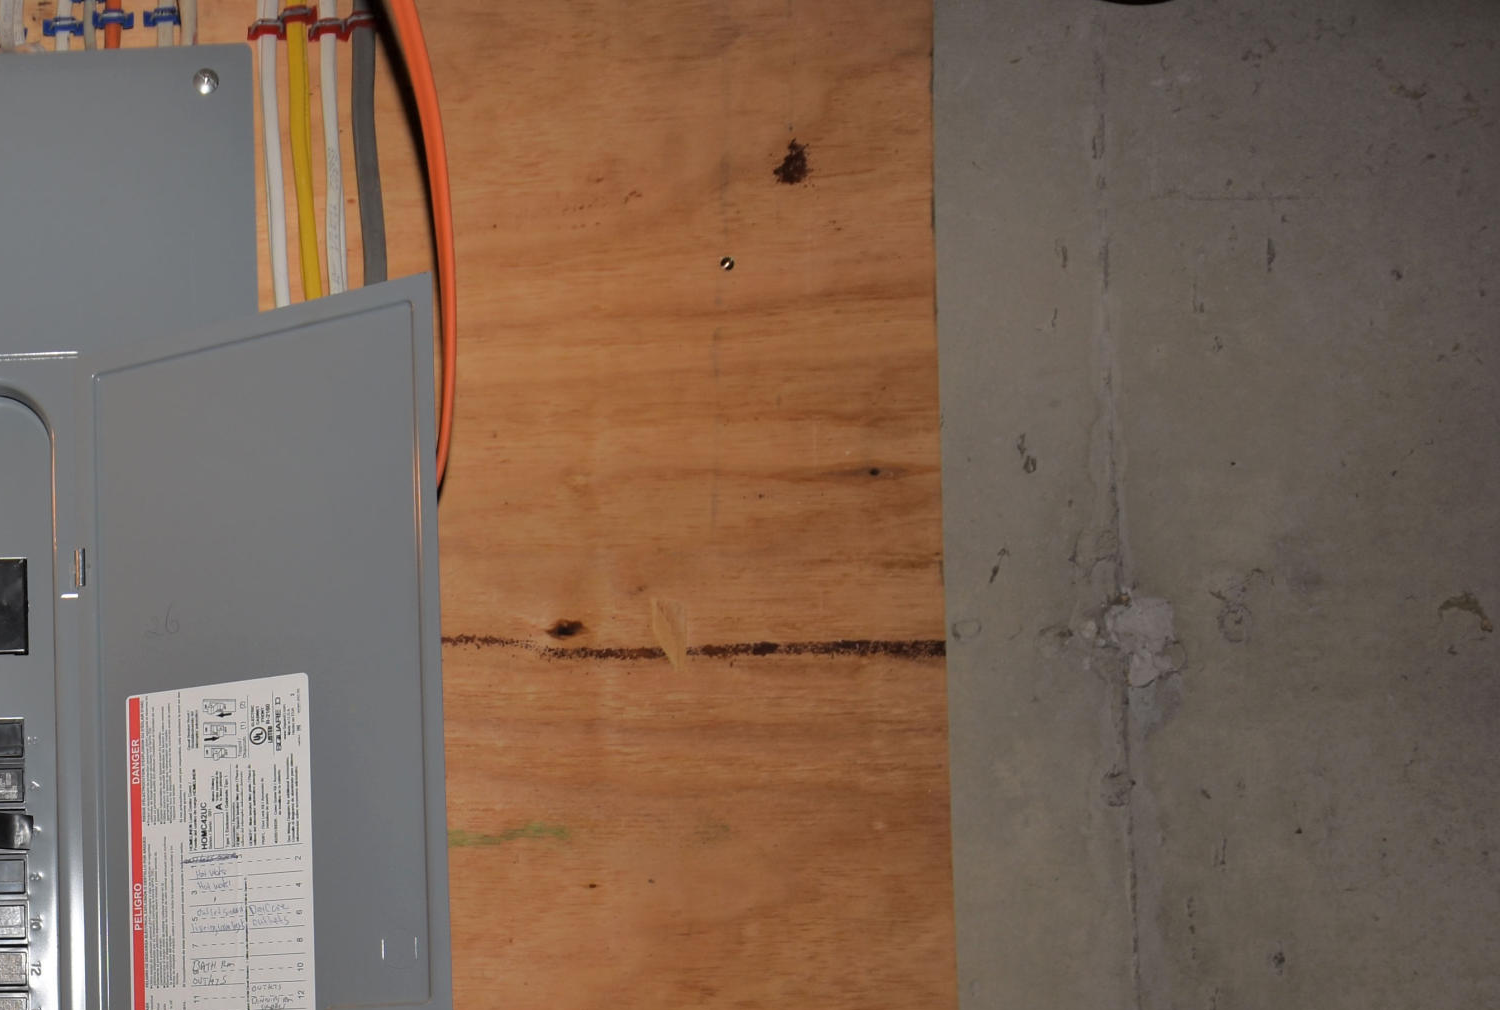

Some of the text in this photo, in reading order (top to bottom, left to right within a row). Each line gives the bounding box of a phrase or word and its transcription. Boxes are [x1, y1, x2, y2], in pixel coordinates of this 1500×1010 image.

[131, 738, 140, 785] DANGER
[200, 802, 208, 851] HOMC42UC
[215, 803, 223, 811] A
[133, 883, 143, 931] PELIGRO
[30, 961, 42, 976] 12
